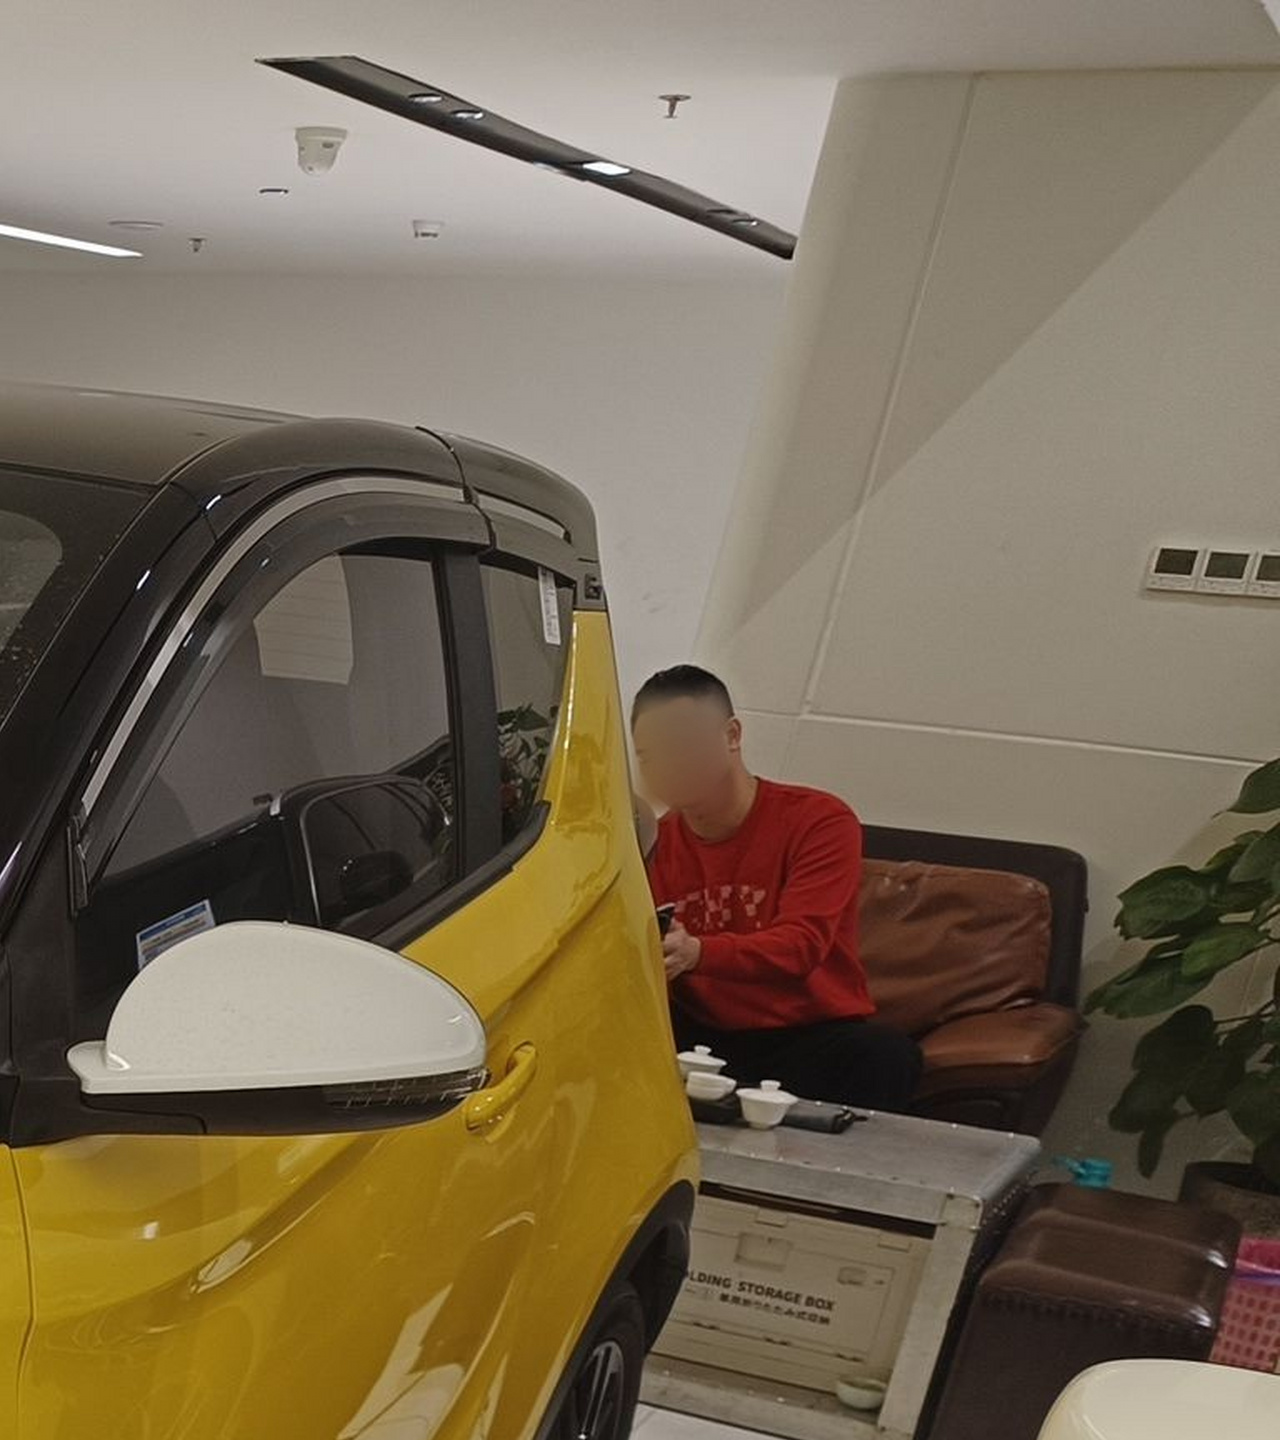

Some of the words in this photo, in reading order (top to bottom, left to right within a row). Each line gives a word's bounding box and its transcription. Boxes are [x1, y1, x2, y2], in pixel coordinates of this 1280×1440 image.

[687, 1270, 732, 1289] LDING
[738, 1281, 803, 1306] STORAGE
[805, 1296, 835, 1311] BOX
